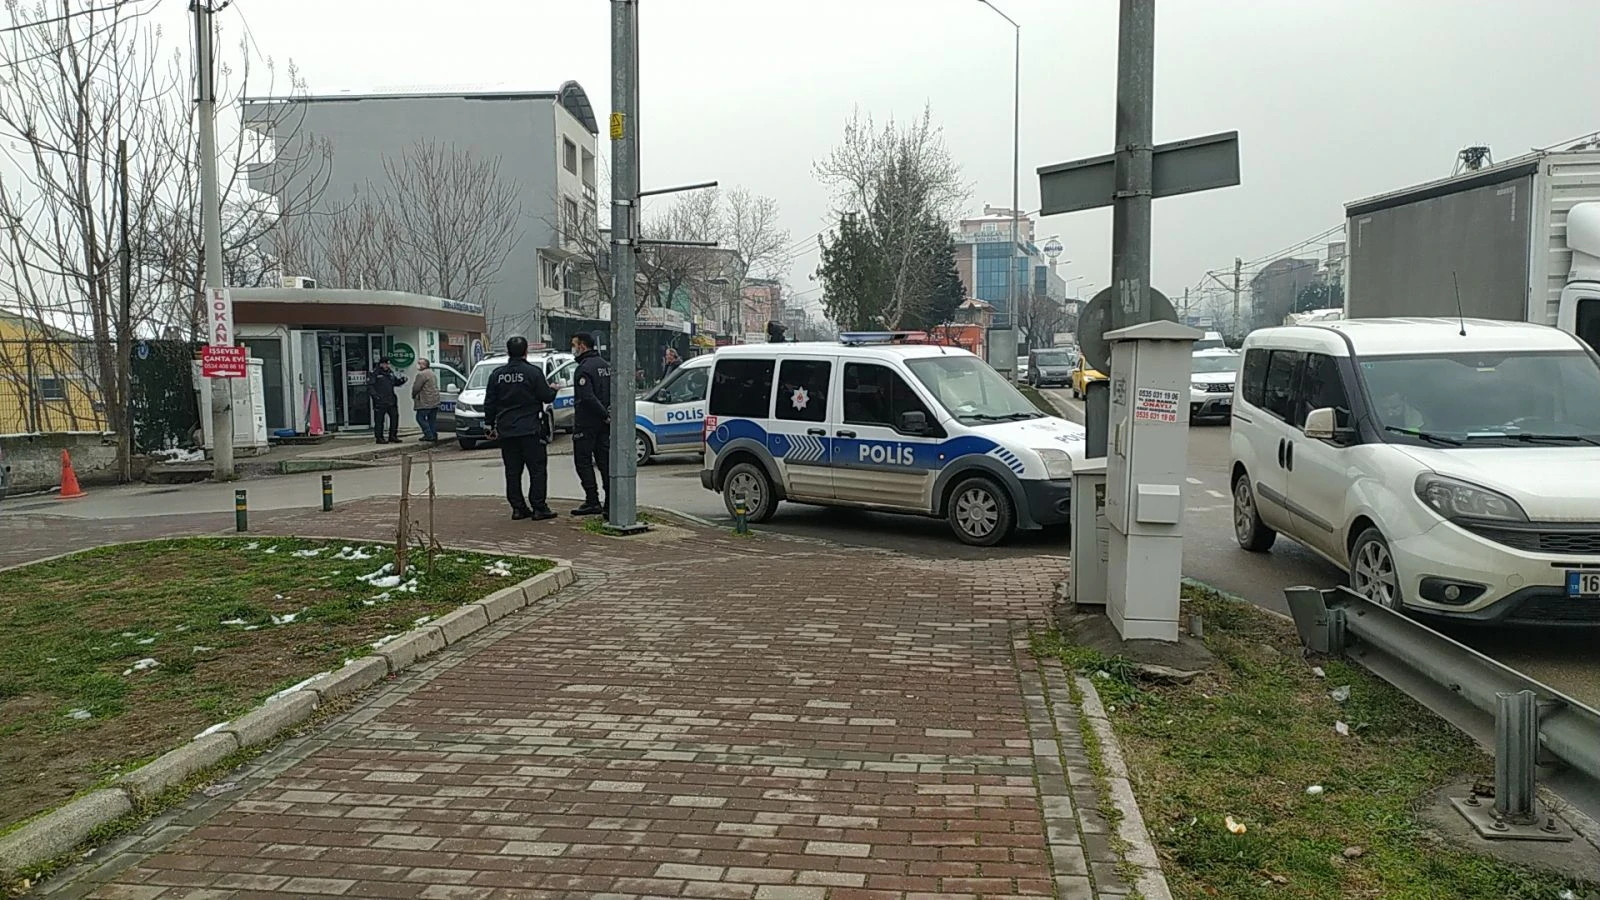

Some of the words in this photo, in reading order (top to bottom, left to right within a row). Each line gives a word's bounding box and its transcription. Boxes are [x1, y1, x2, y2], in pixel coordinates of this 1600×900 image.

[213, 291, 228, 347] LOKAN
[1139, 389, 1152, 397] 0535
[667, 408, 704, 421] POLİS
[859, 442, 914, 466] POLİS
[1582, 575, 1599, 592] 16
